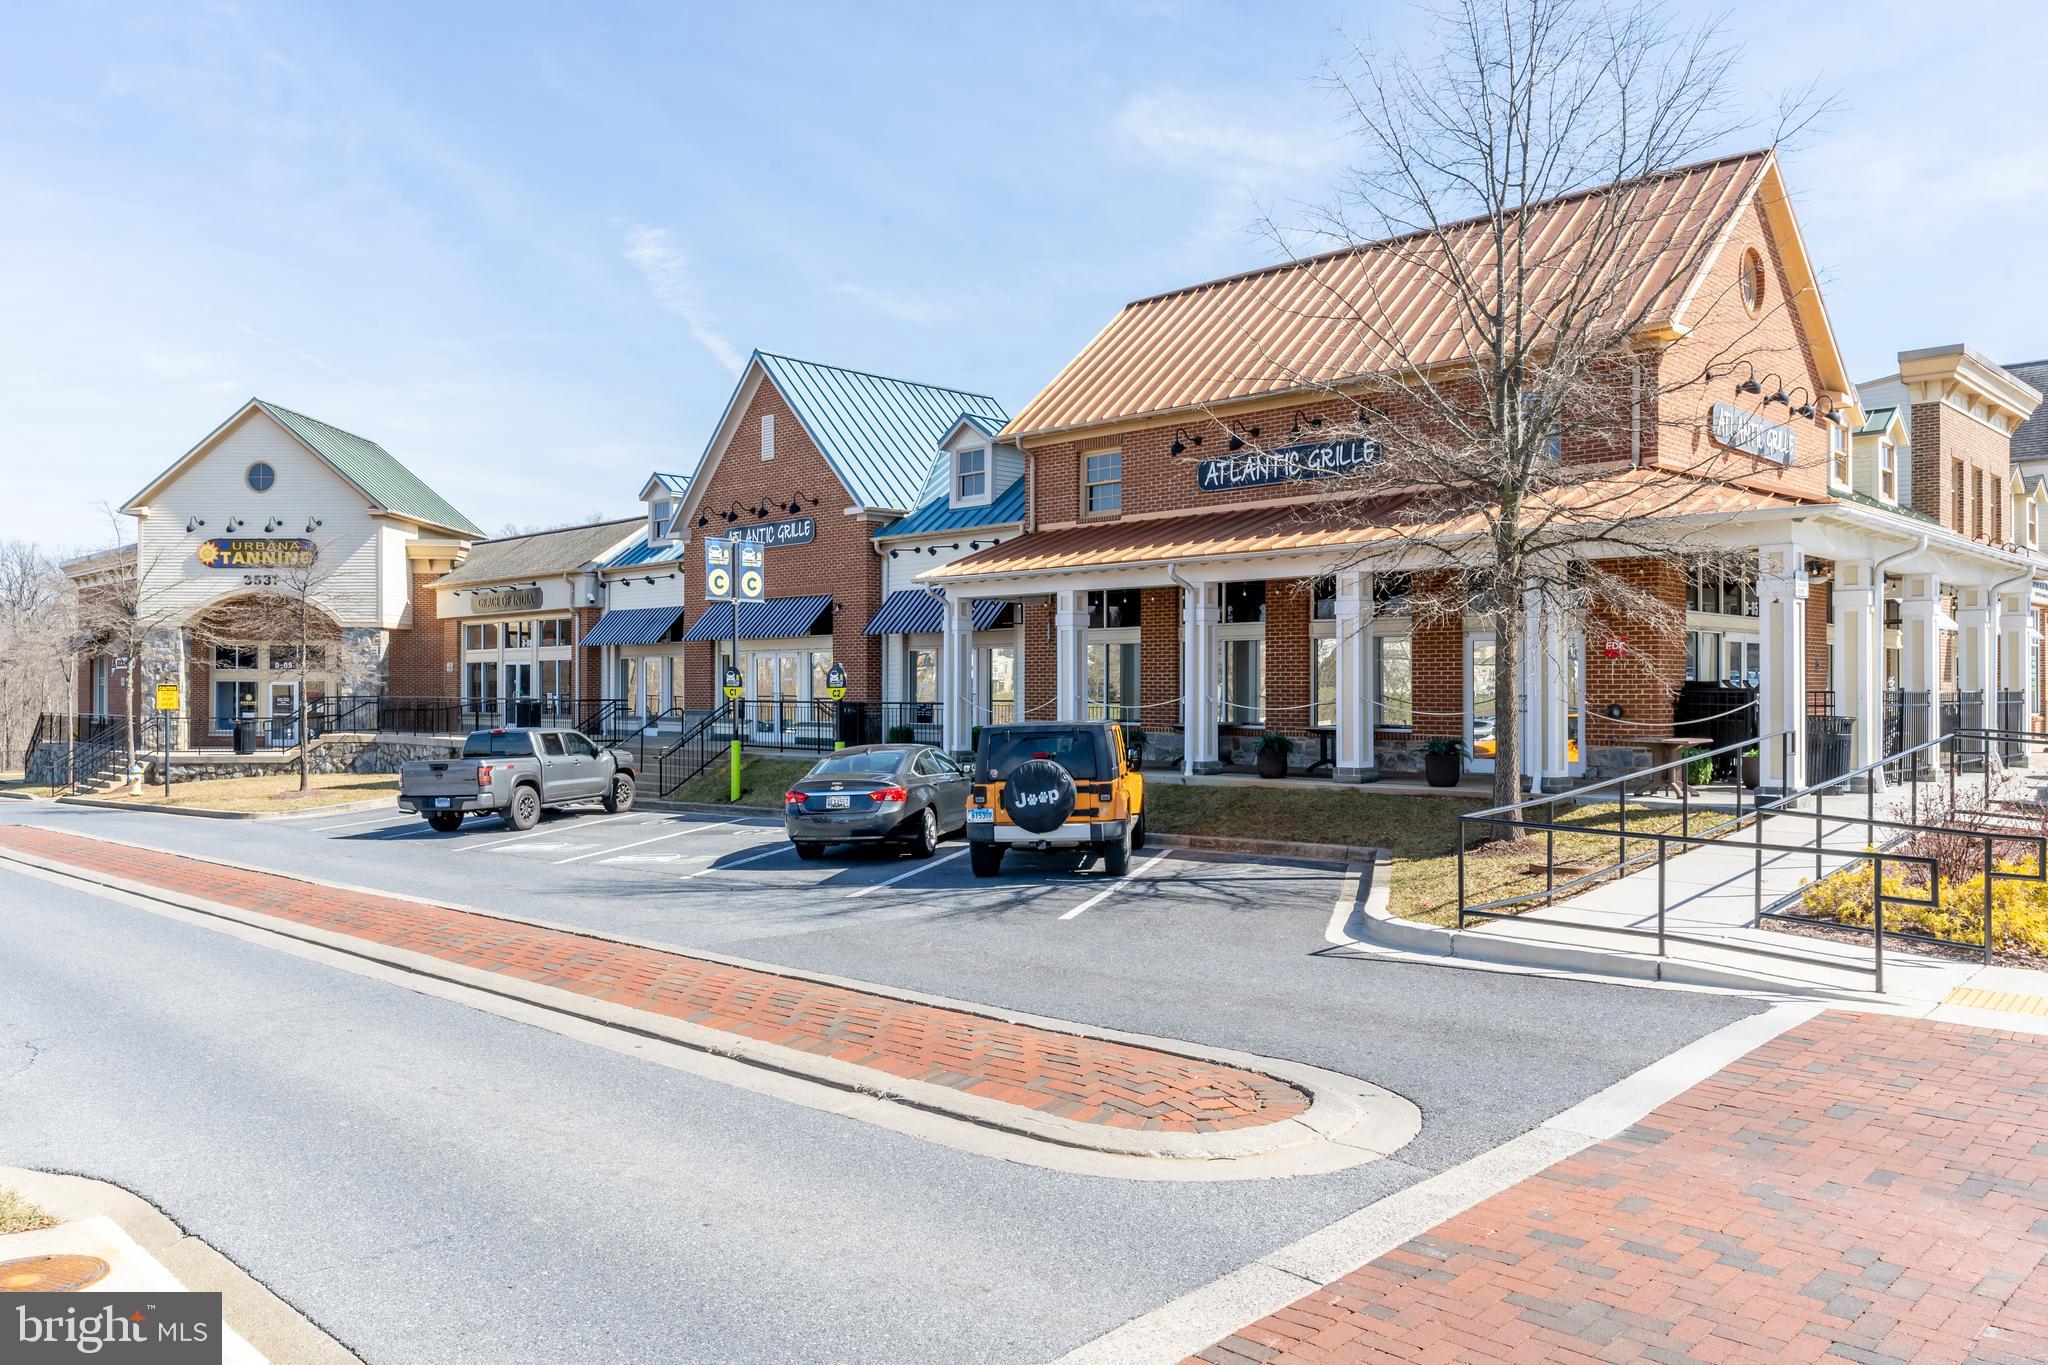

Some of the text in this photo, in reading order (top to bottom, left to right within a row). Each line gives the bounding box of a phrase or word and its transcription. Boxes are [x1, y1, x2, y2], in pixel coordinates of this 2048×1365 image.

[1204, 440, 1375, 486] ATLANTIC GRILLE
[777, 520, 811, 543] GRILLE
[232, 541, 300, 551] URBANA
[714, 575, 724, 589] C
[747, 577, 757, 591] C
[502, 594, 511, 607] OF
[513, 593, 535, 606] INDIA
[729, 688, 737, 696] C1
[832, 689, 841, 697] C2
